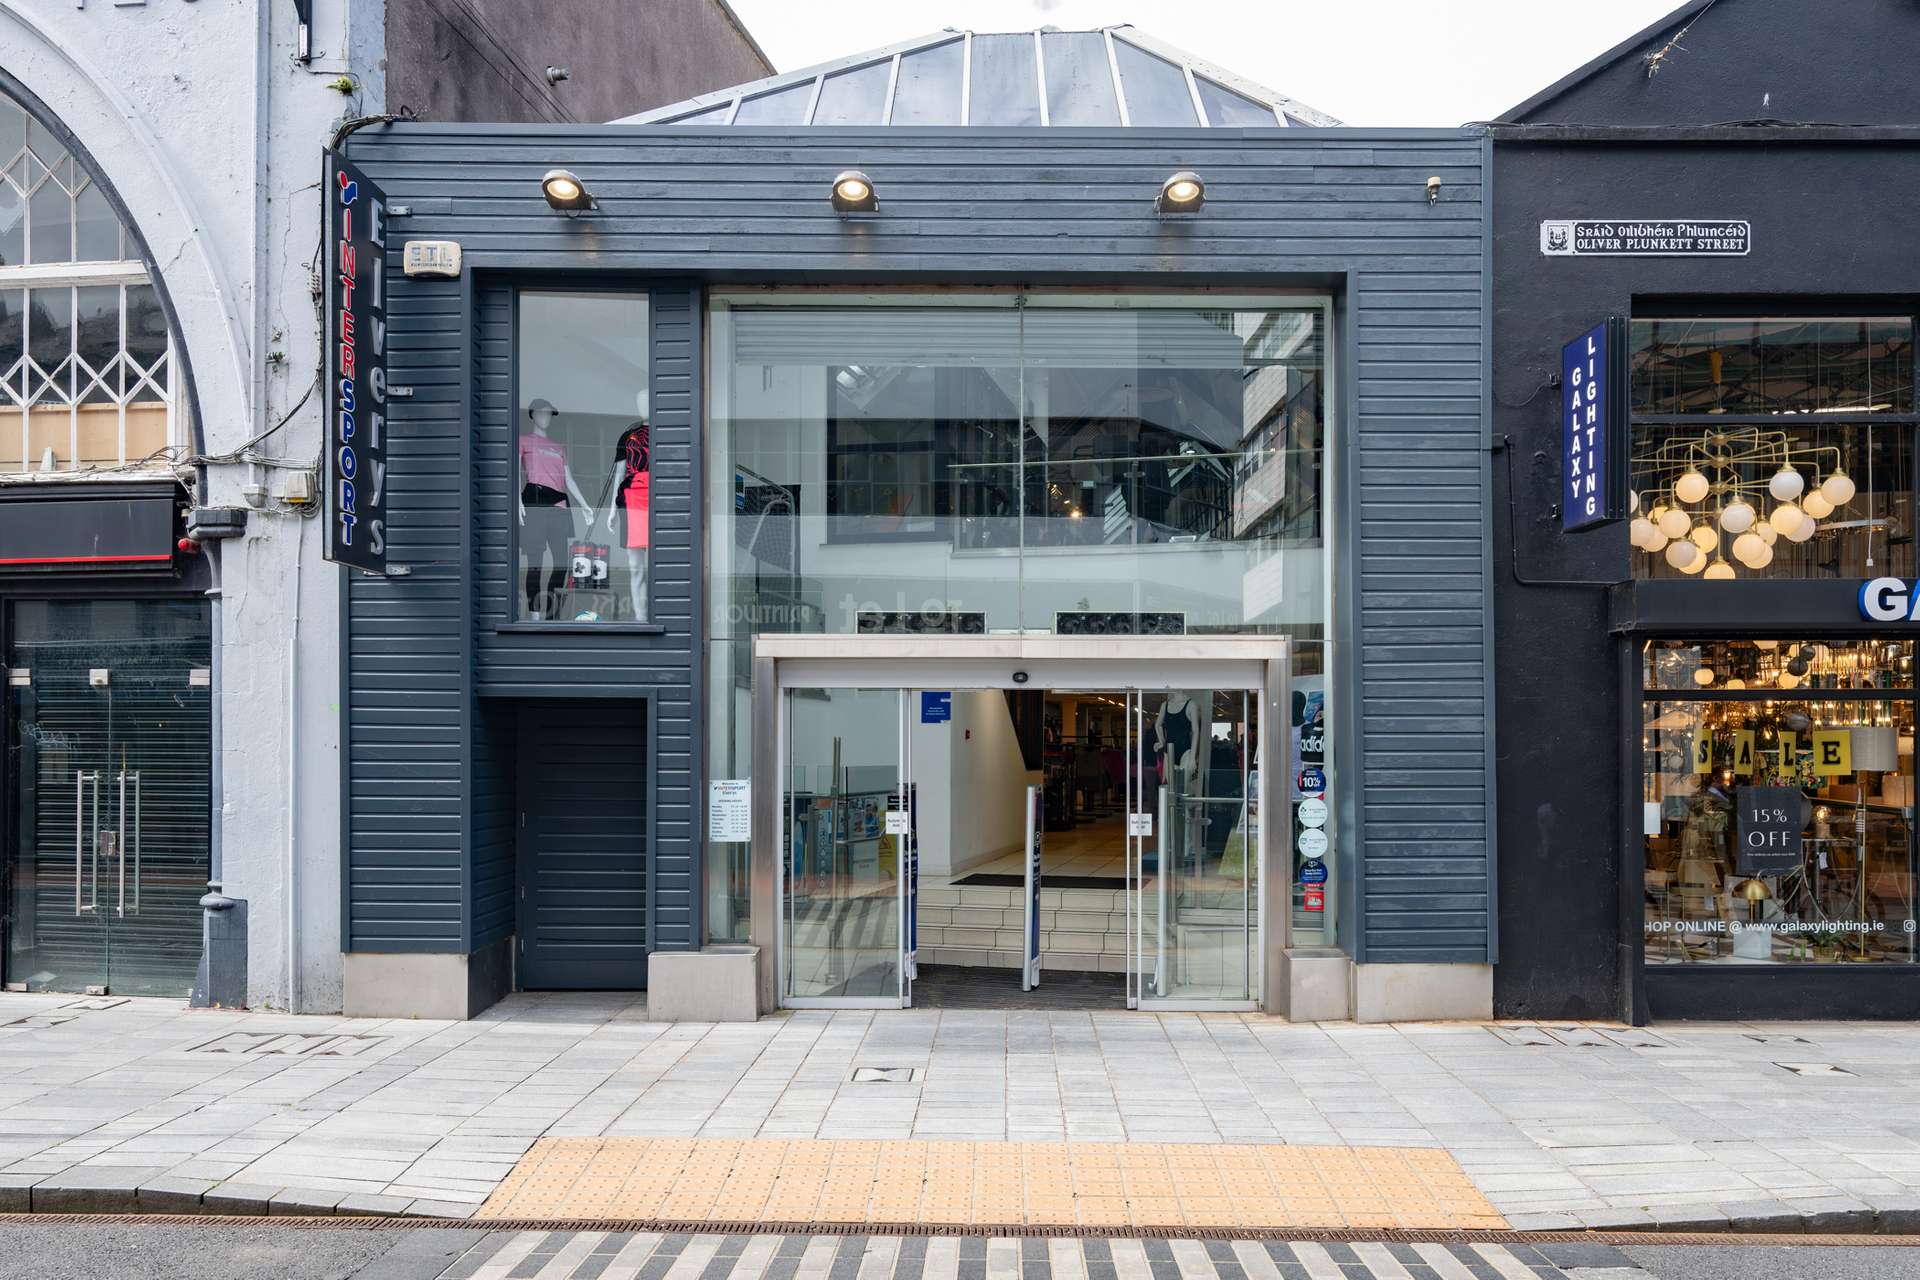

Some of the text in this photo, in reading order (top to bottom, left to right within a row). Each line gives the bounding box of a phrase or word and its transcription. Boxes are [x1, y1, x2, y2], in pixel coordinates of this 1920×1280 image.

[1576, 224, 1614, 238] Sráid
[1576, 238, 1745, 250] OLIVER PLUNKETT STREET
[338, 207, 358, 546] INTERSPORT
[369, 197, 386, 556] Elverys
[1571, 366, 1582, 499] GALAXY
[1585, 336, 1597, 516] LIGHTING
[1858, 577, 1920, 622] G
[1300, 735, 1327, 753] adid
[1697, 739, 1842, 765] SALE
[1752, 808, 1788, 823] 15%
[1748, 831, 1791, 847] OFF
[1674, 920, 1726, 932] ONLINE
[1729, 920, 1742, 934] @
[1745, 920, 1885, 934] www.galaxylighting.ie
